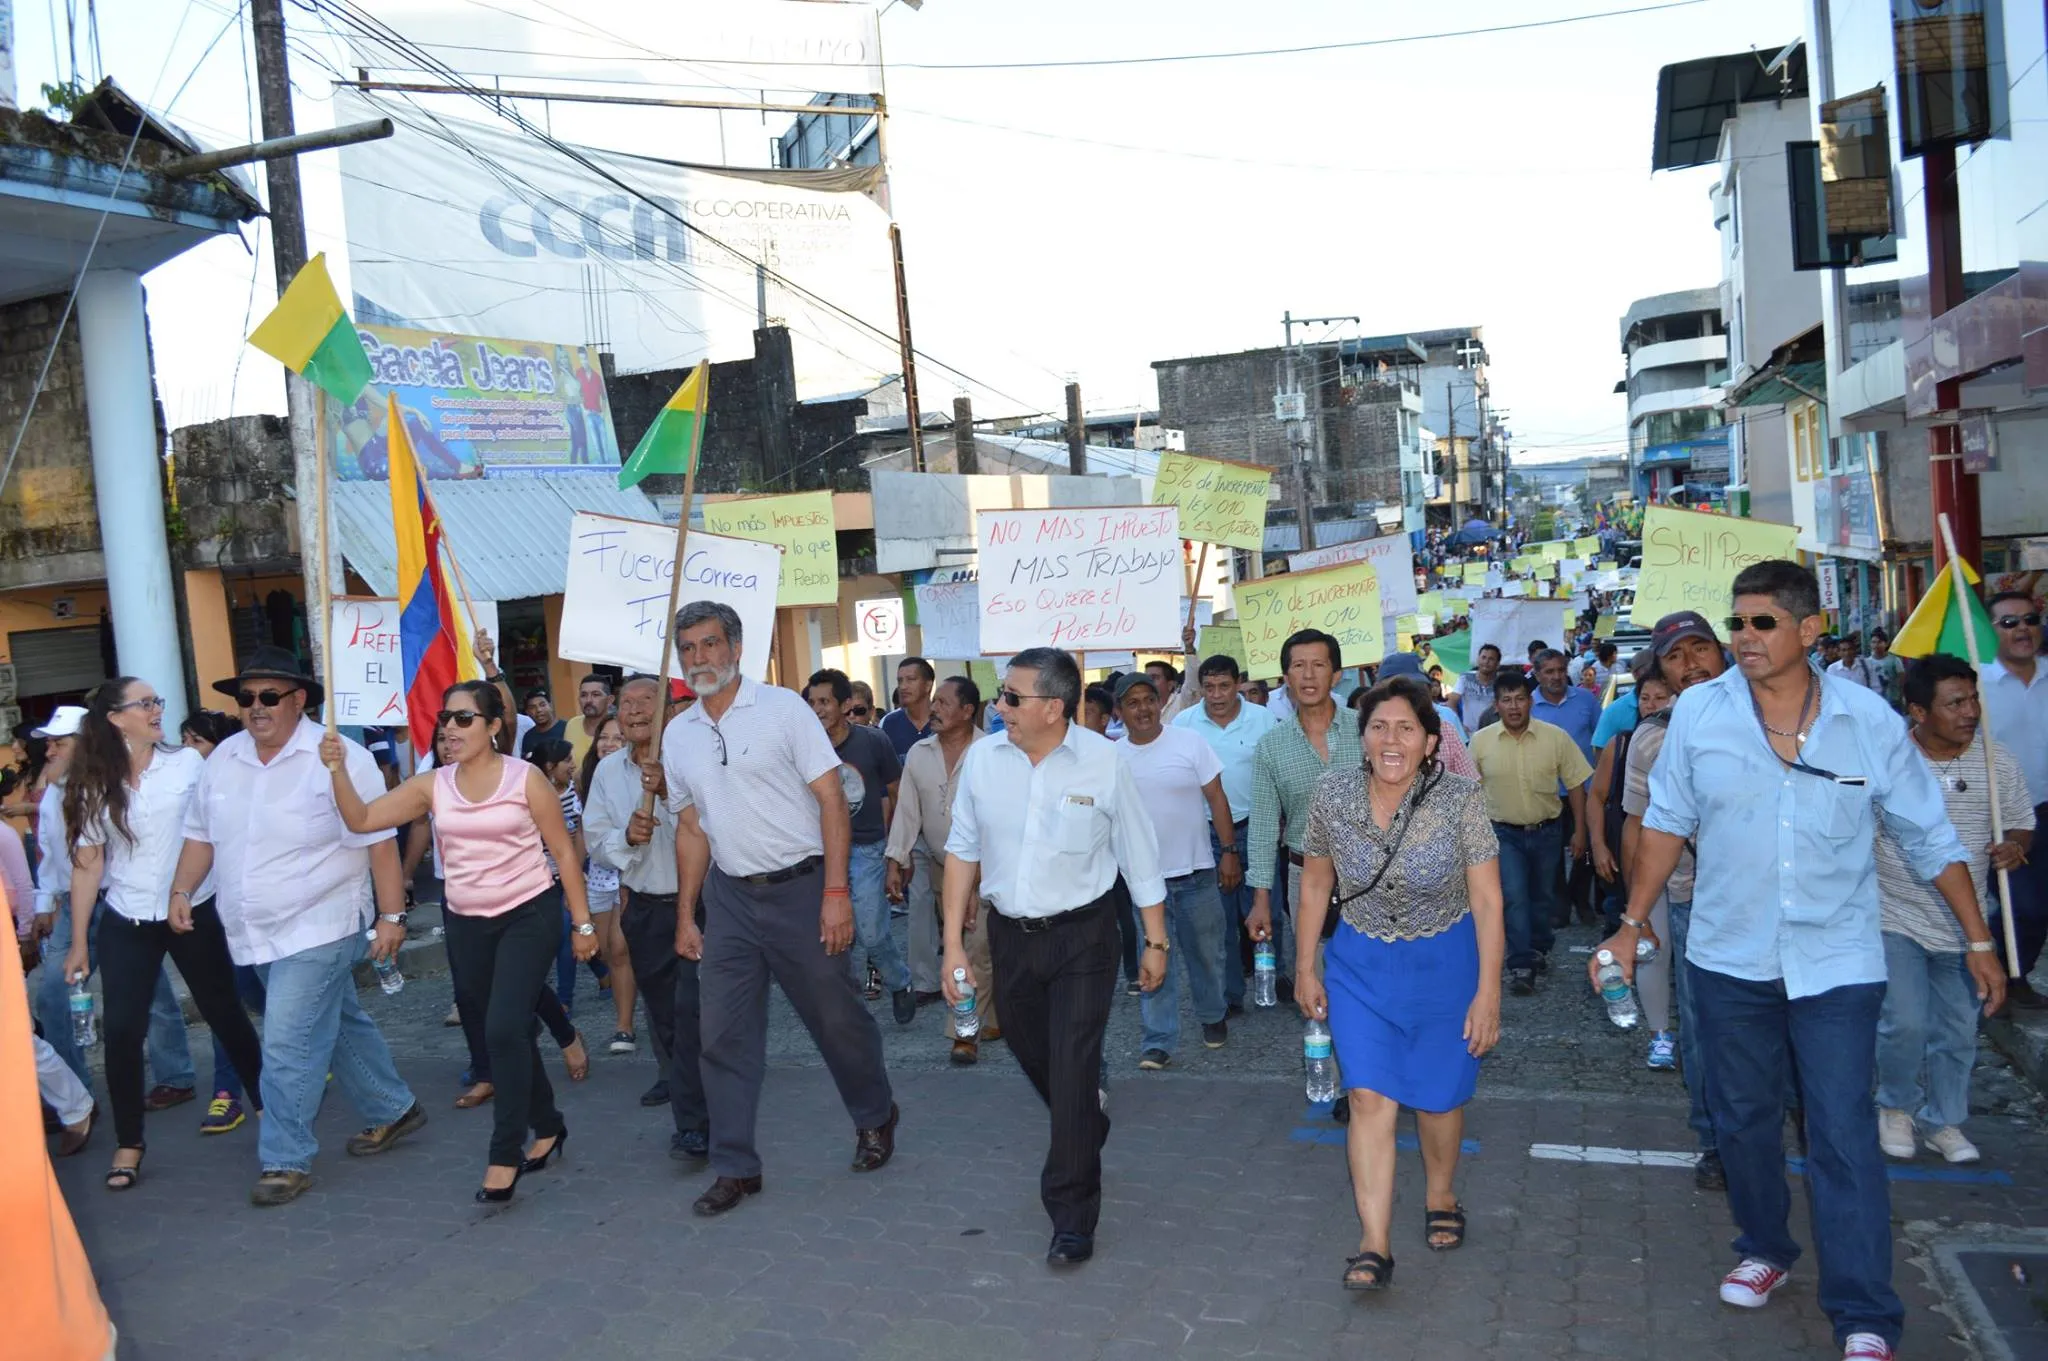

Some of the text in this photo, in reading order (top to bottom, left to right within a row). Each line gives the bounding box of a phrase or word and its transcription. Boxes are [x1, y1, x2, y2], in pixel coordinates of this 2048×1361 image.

[693, 199, 852, 221] COOPERATIVA
[471, 341, 555, 394] Jeans
[1160, 461, 1199, 489] 5%
[1216, 499, 1246, 516] 010
[711, 518, 732, 533] No
[988, 520, 1022, 547] NO
[1036, 515, 1085, 544] MAS
[1650, 527, 1713, 570] Shell
[684, 551, 759, 592] Correa
[1010, 554, 1070, 585] MAS
[1823, 567, 1834, 606] FOTOS
[1243, 588, 1284, 622] 5%
[1323, 605, 1361, 628] 010
[366, 662, 388, 684] EL
